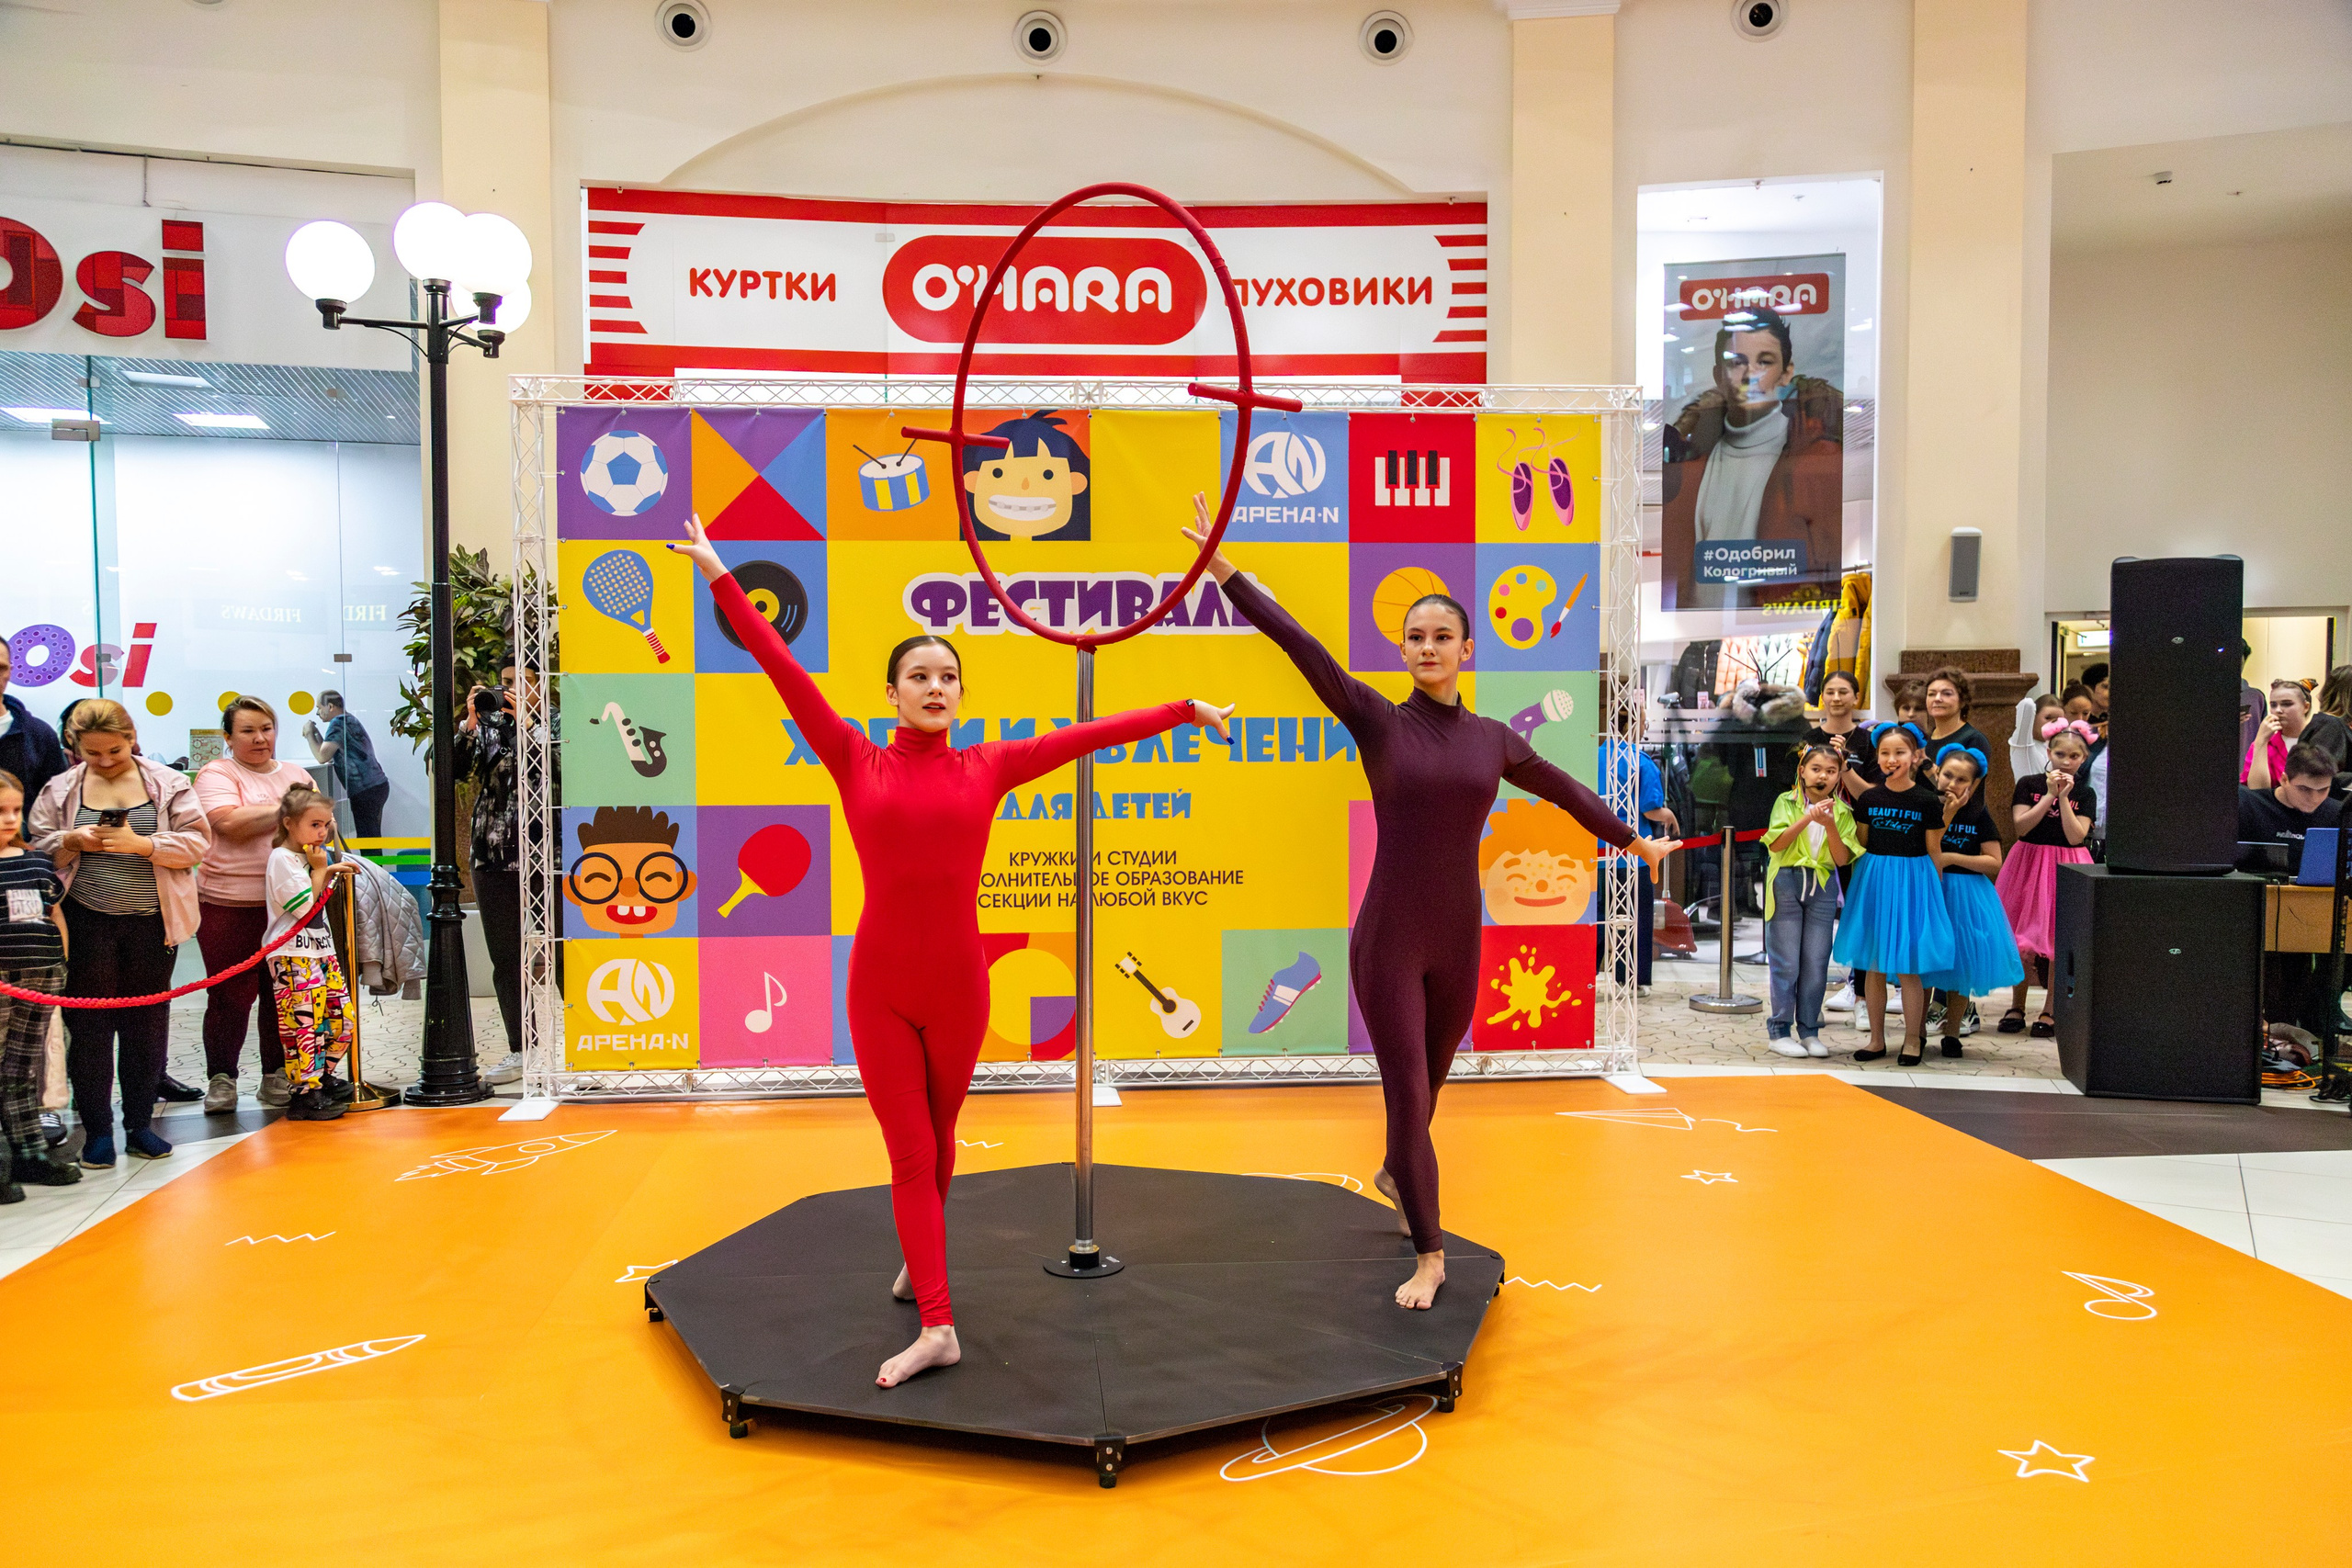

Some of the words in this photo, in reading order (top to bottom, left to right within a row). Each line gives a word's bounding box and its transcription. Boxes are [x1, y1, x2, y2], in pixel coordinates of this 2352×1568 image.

[689, 267, 837, 302] КУРТКИ
[912, 263, 1173, 314] O'HARA
[1703, 546, 1796, 562] #Одобрил
[1703, 563, 1798, 578] Кологривый
[996, 792, 1073, 820] ДЛЯ
[1092, 788, 1192, 819] ДЕТЕЙ
[1868, 807, 1923, 822] BEAUTIFUL
[1107, 850, 1177, 868] СТУДИИ
[1115, 870, 1244, 886] ОБРАЗОВАНИЕ
[978, 892, 1052, 910] СЕКЦИИ
[1162, 891, 1208, 906] ВКУС
